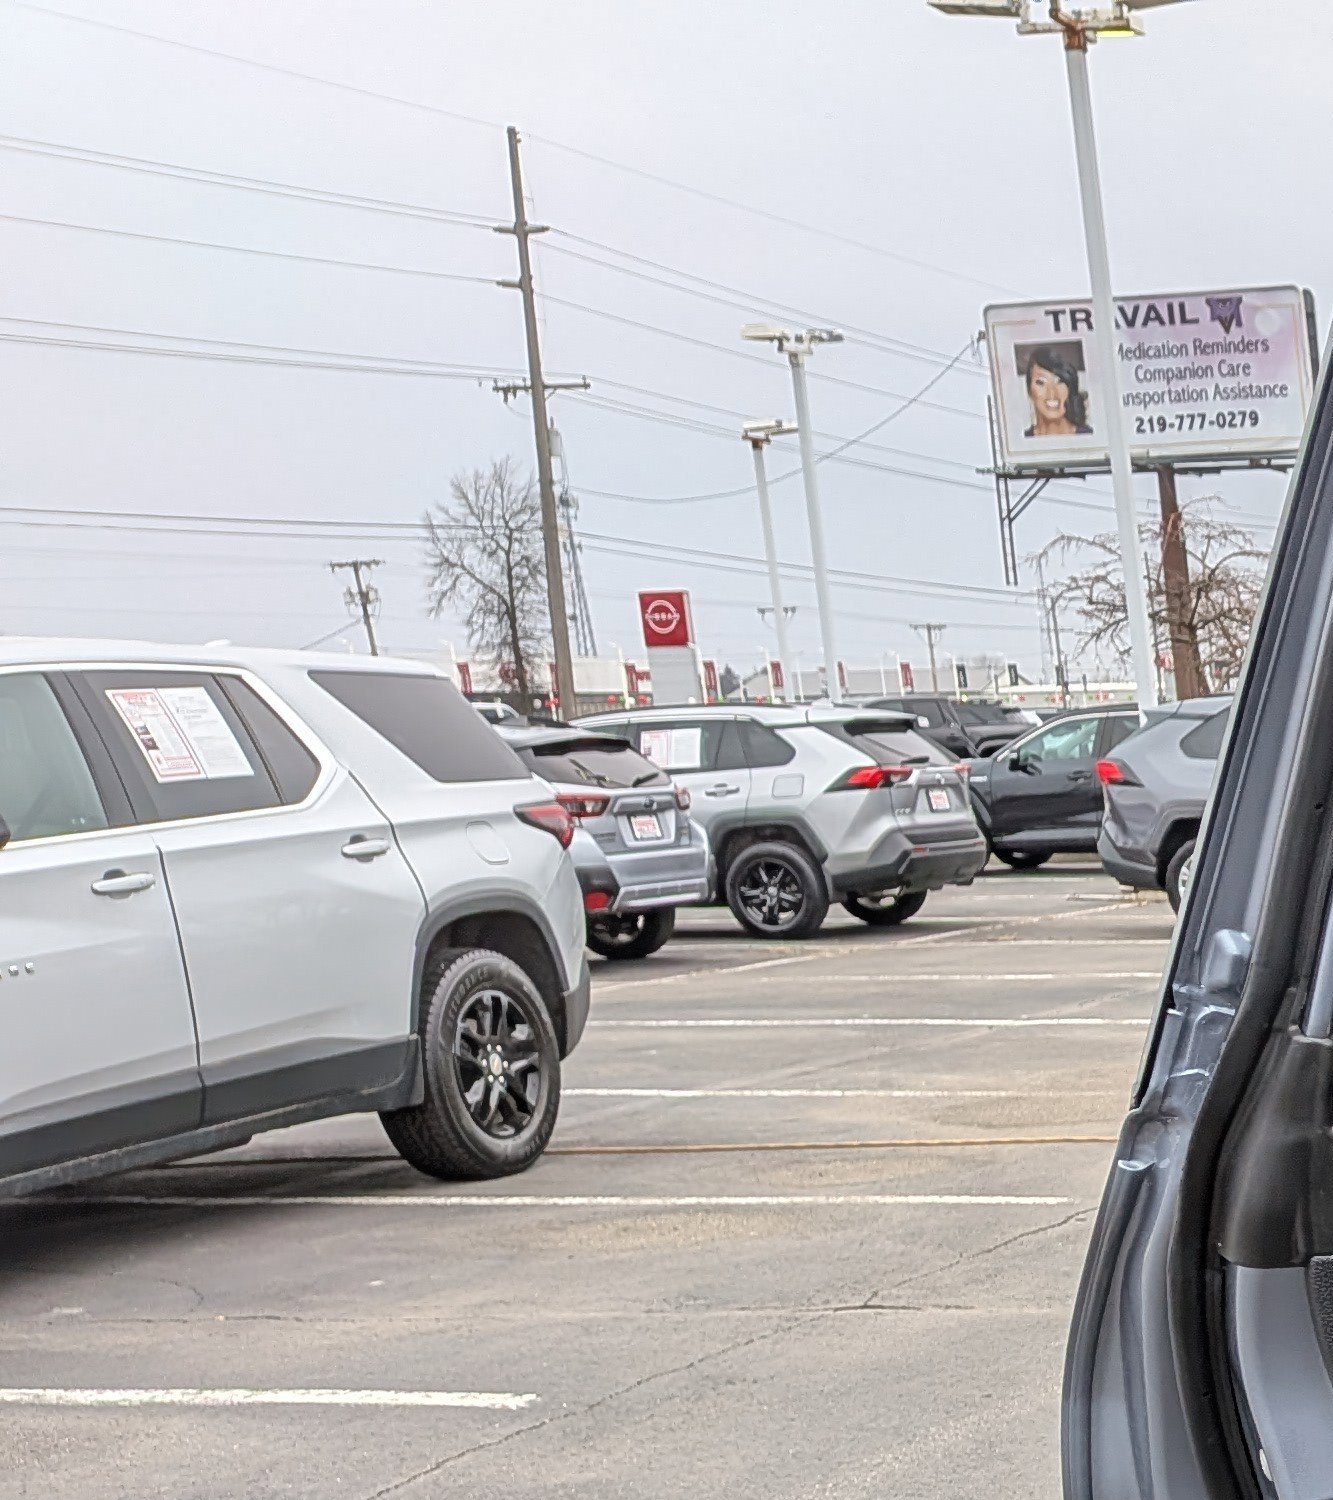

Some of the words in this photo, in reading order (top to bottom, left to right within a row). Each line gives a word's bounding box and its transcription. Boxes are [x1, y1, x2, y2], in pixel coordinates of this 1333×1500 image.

[1044, 300, 1200, 333] TRVAIL
[1193, 335, 1271, 356] Reminders
[1134, 360, 1214, 385] Companion
[1217, 359, 1252, 379] Care
[1122, 384, 1209, 410] nsportation
[1213, 382, 1289, 402] Assistance
[1135, 409, 1260, 435] 219-777-0279
